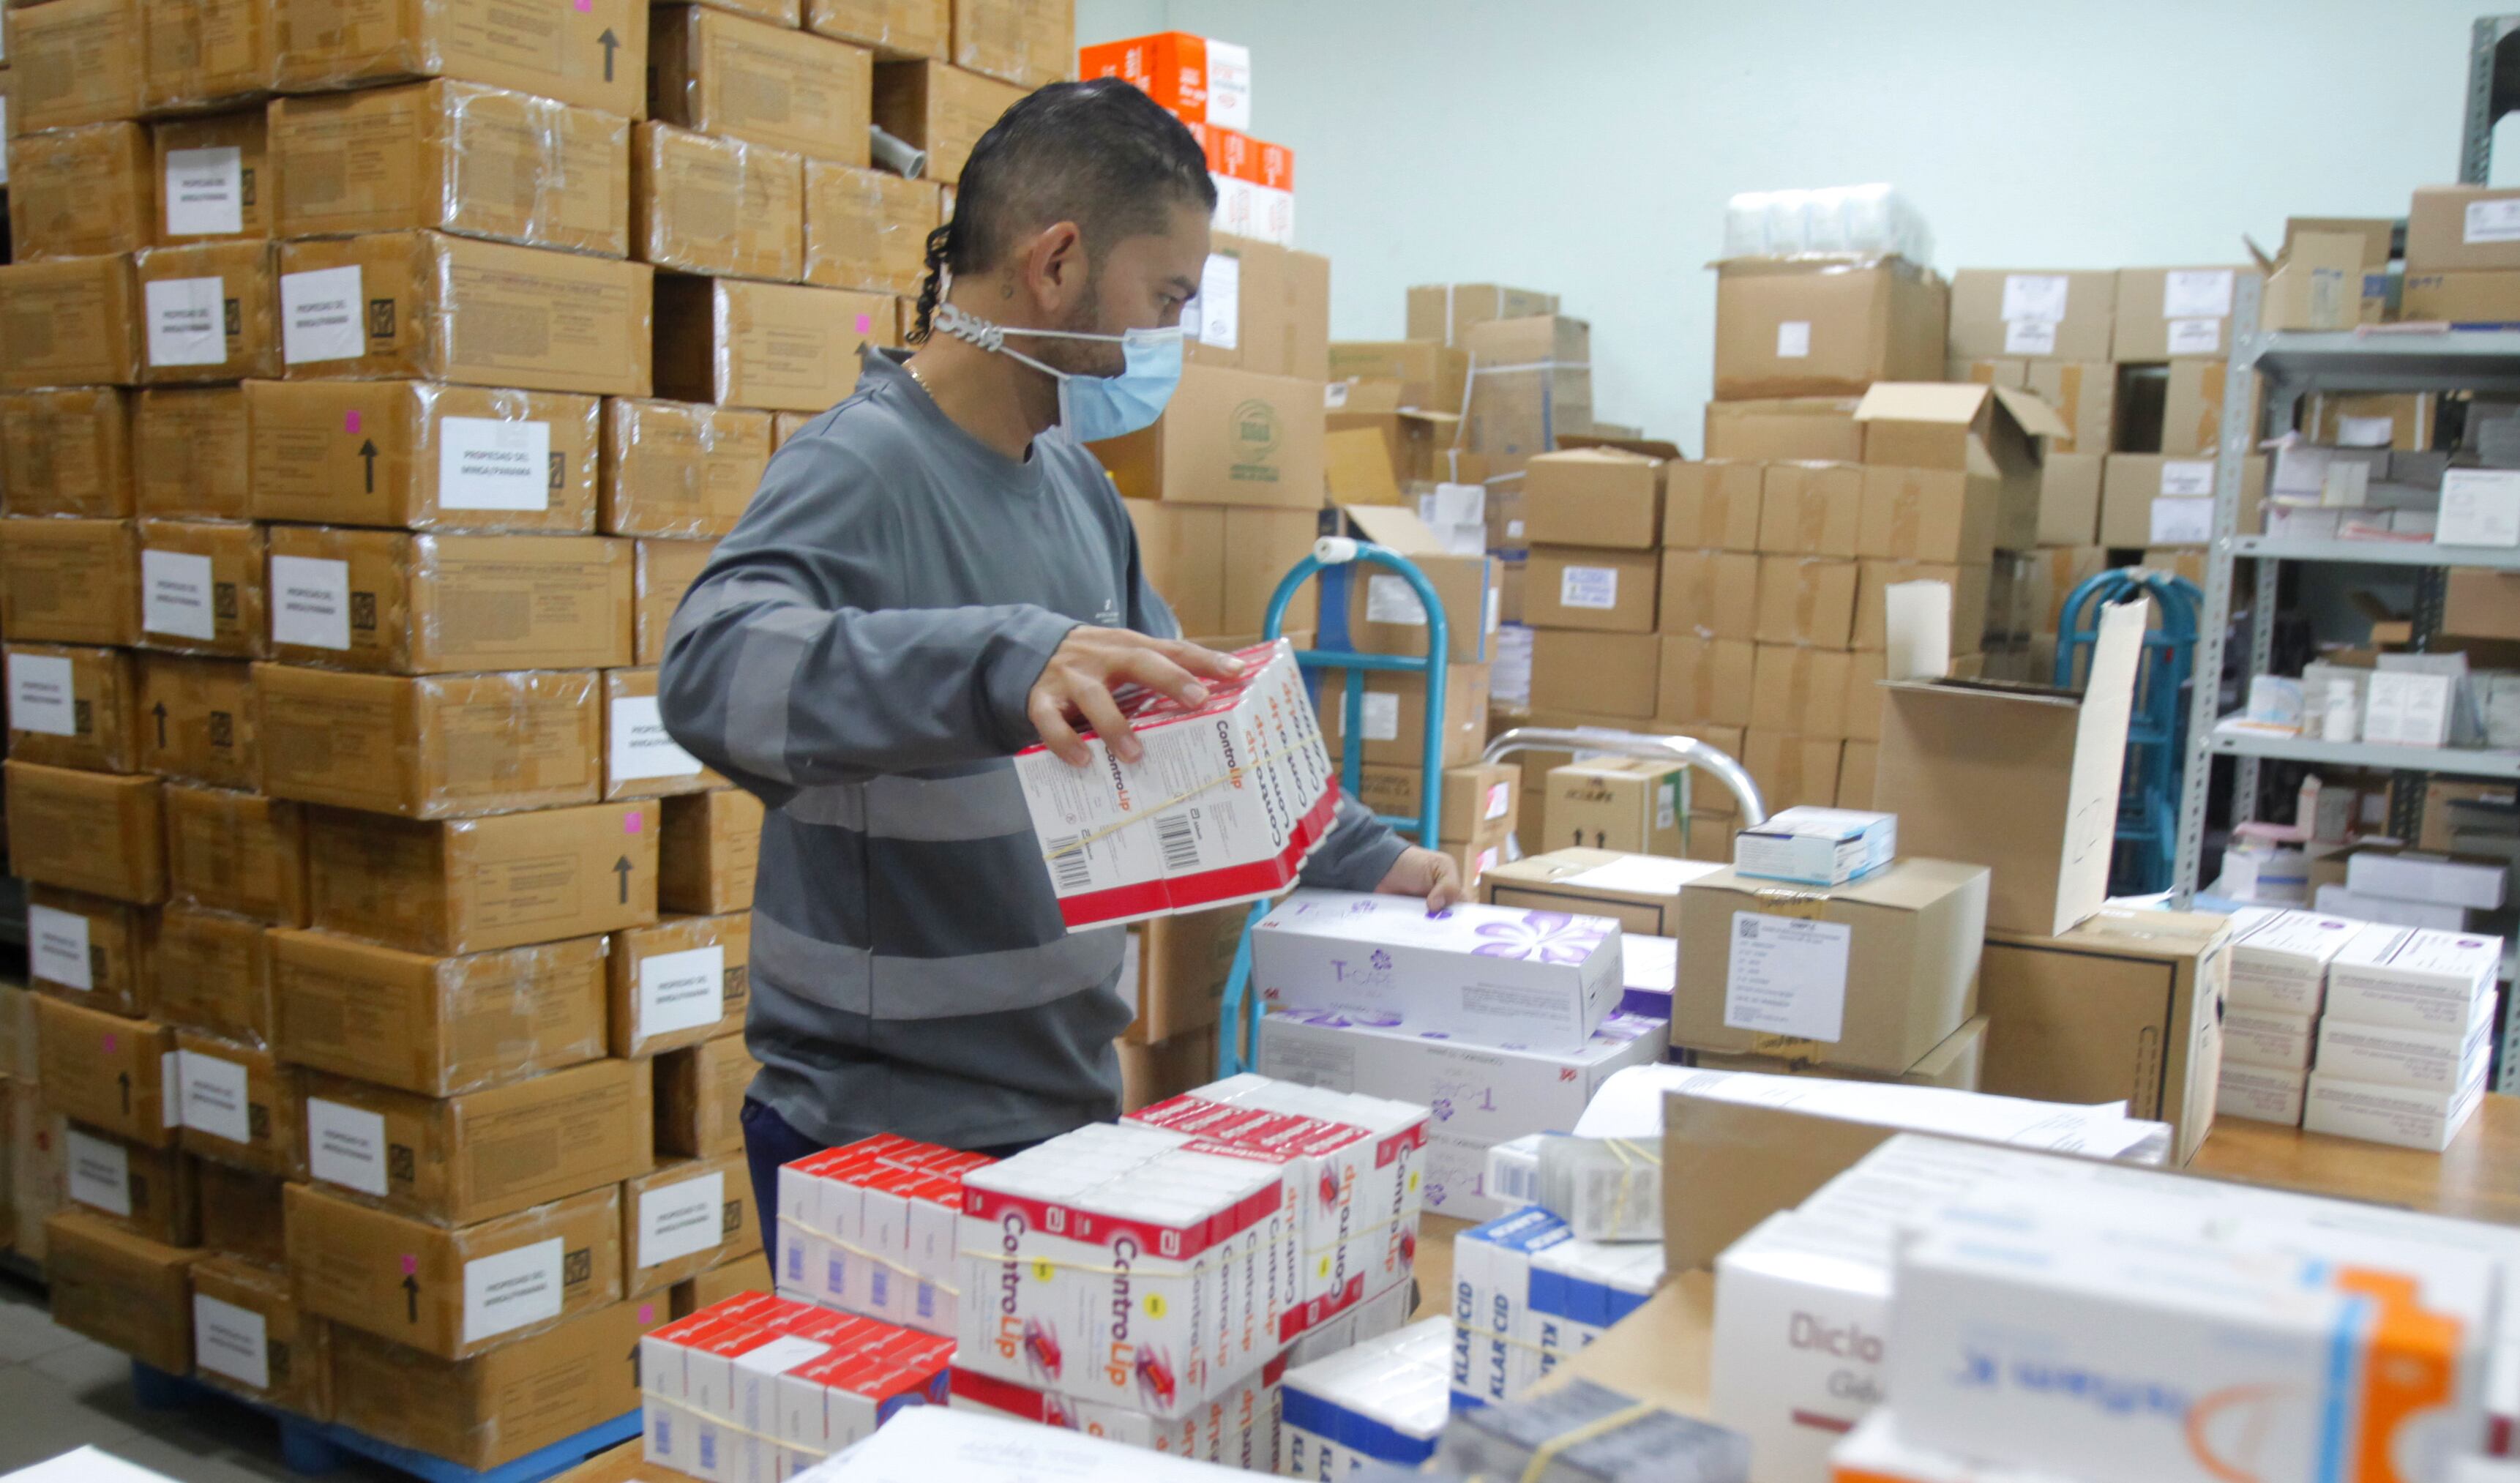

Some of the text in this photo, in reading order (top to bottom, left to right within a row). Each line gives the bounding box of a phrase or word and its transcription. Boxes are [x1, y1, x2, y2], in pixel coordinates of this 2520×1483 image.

[1216, 720, 1242, 789] ControLip
[995, 1212, 1025, 1359] ControLip
[1104, 1236, 1137, 1387] ControLip
[1490, 1293, 1508, 1400] KLARCID
